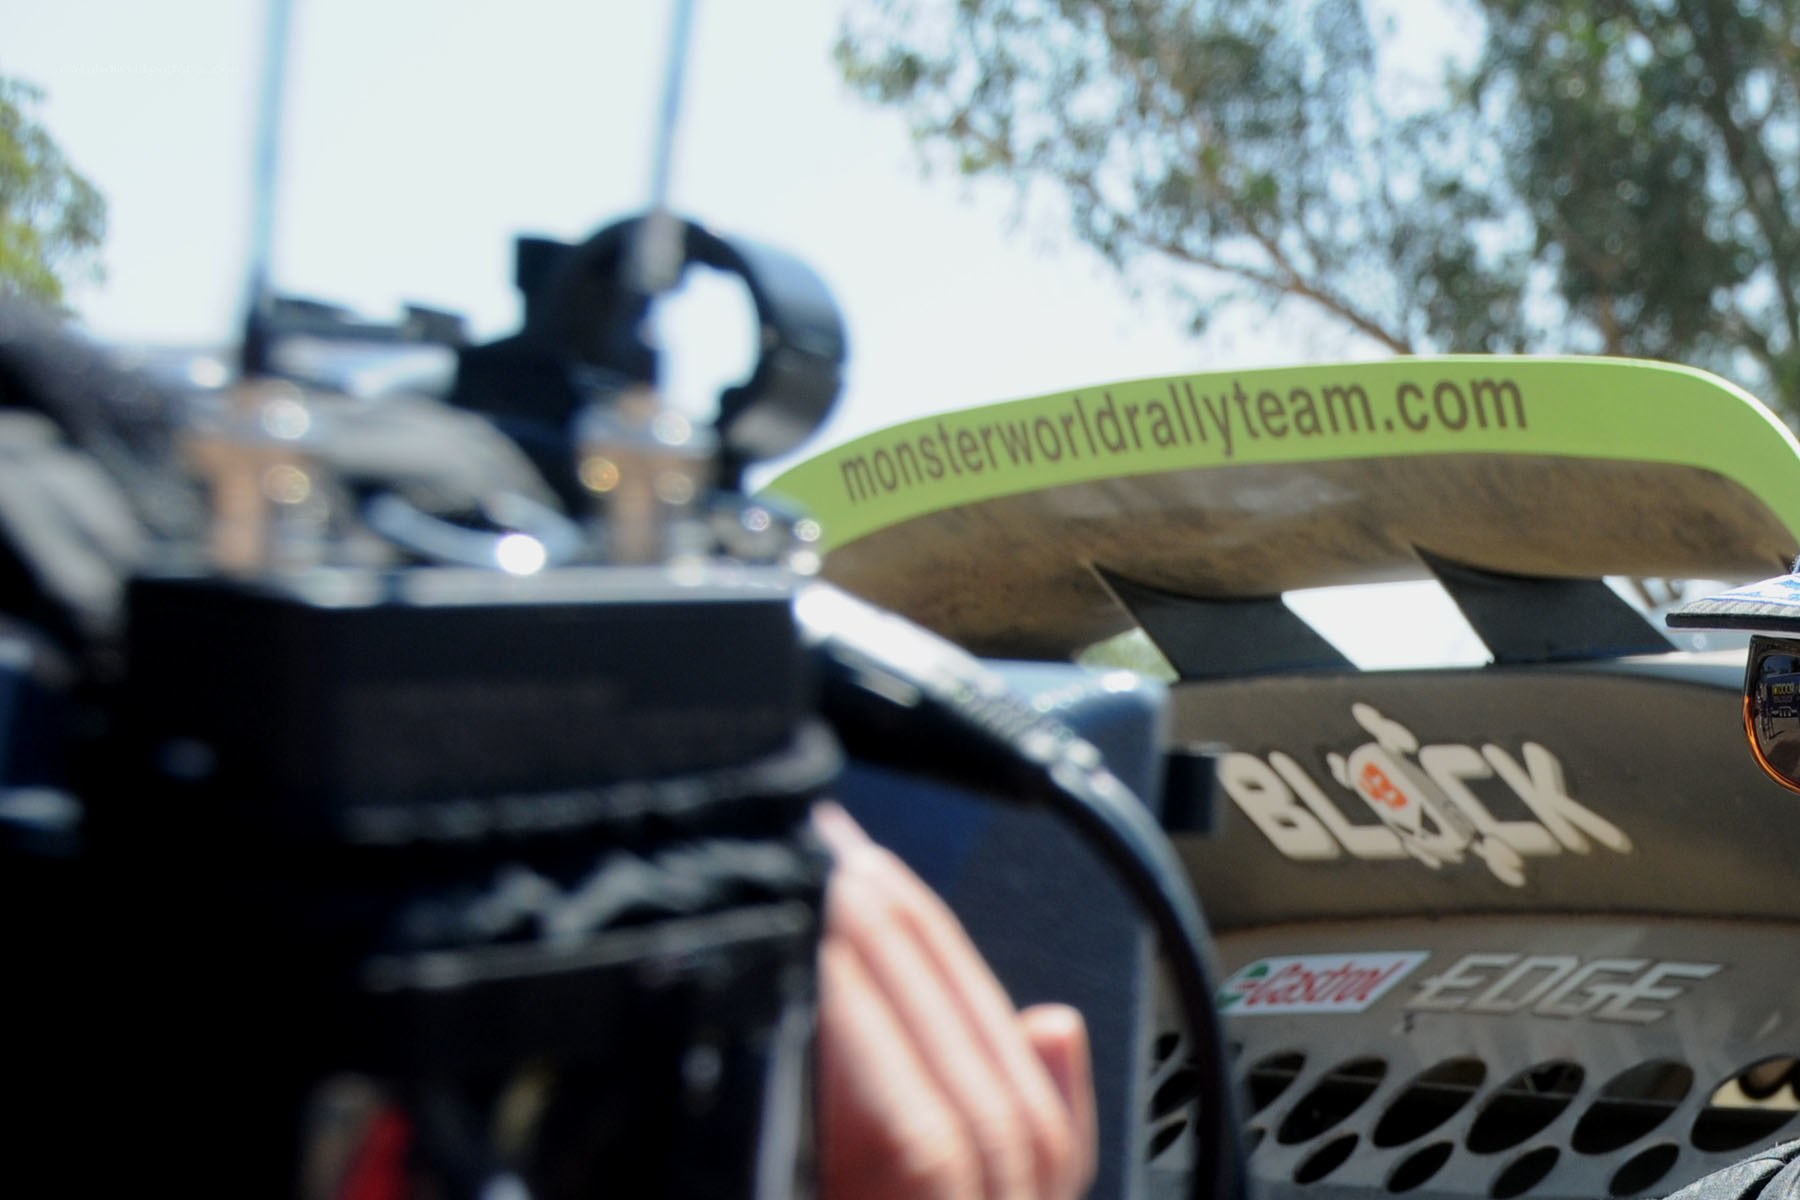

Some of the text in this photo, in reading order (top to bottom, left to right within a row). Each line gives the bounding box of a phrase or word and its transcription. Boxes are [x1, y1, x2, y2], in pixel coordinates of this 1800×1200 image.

[840, 377, 1528, 504] monsterworldrallyteam.com
[1245, 952, 1722, 1025] Castrol EDGE
